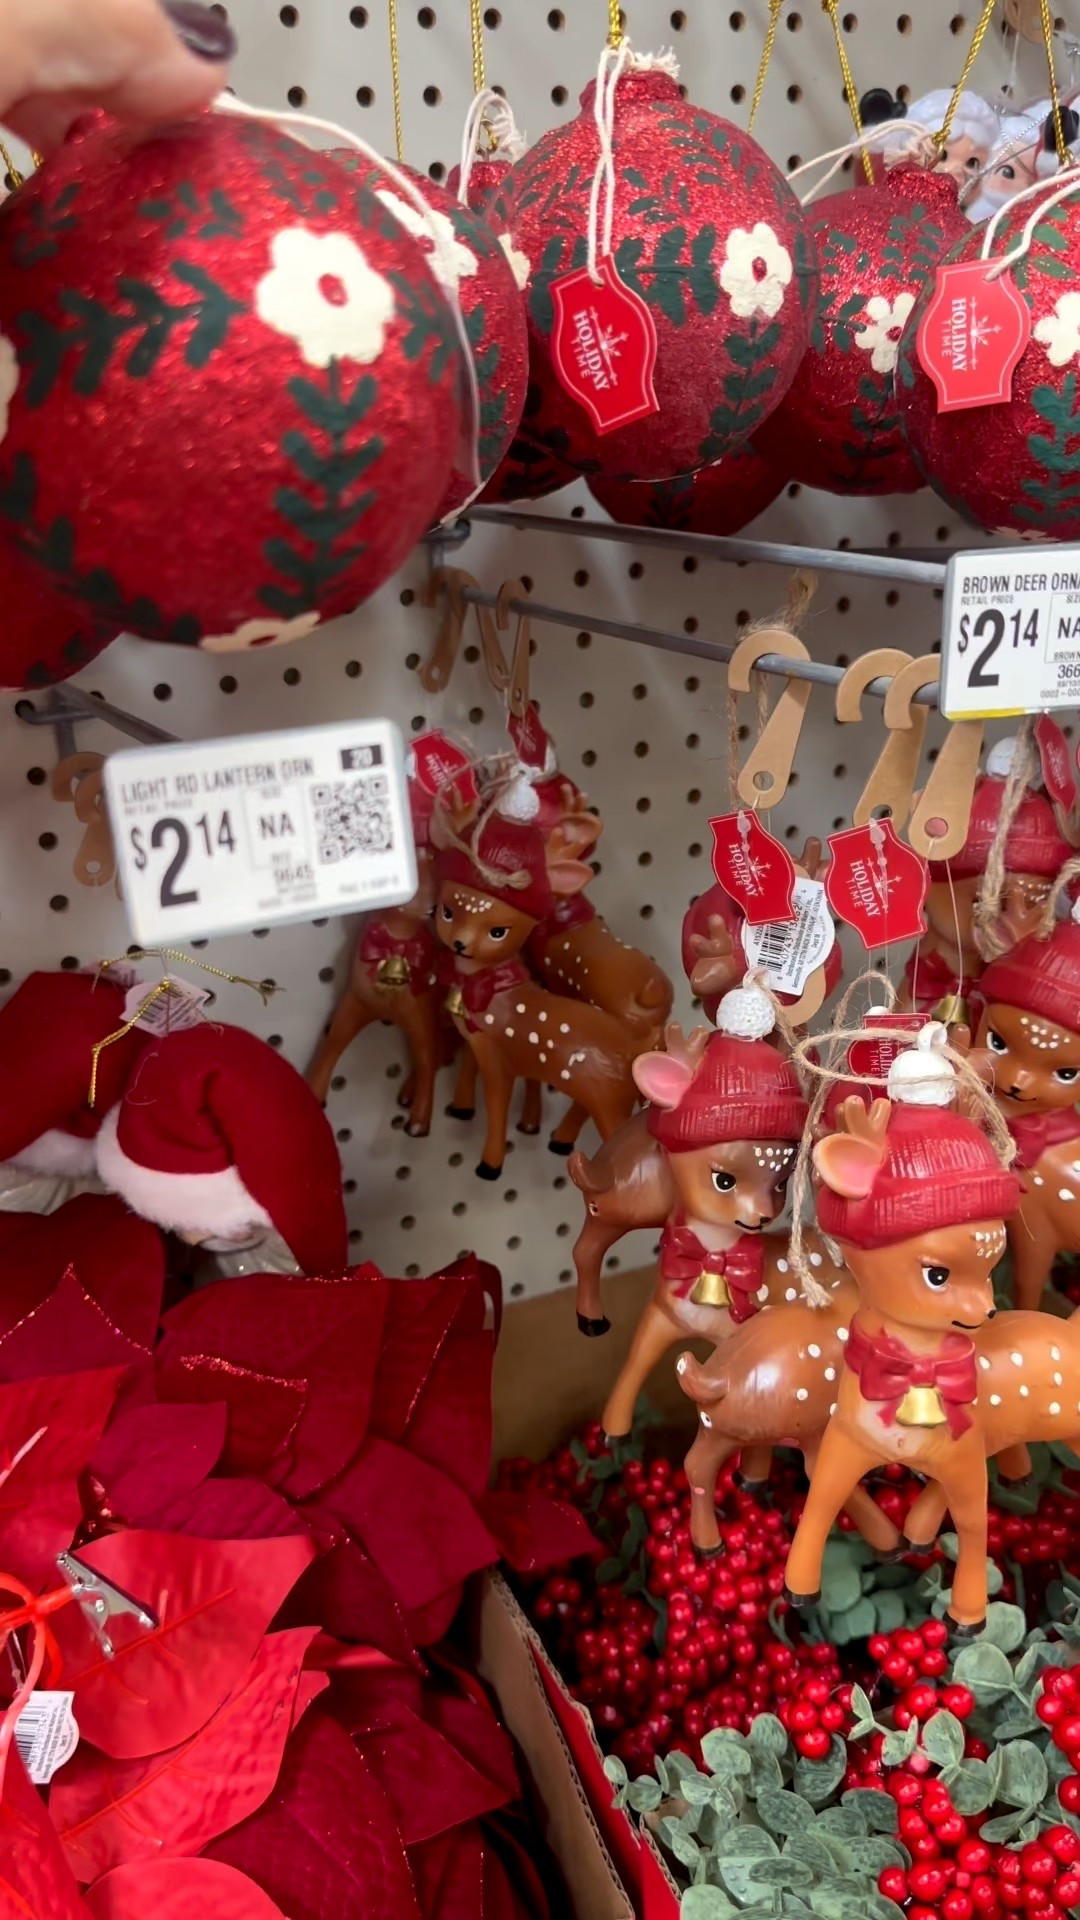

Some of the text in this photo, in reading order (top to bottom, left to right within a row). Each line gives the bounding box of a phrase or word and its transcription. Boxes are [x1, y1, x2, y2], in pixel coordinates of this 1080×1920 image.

[572, 309, 611, 391] HOLIDAY
[941, 319, 952, 358] TIME
[951, 297, 968, 372] HOLIDAY
[571, 337, 591, 379] TIME
[962, 575, 1011, 594] BROWN
[1014, 574, 1047, 592] DEER
[121, 777, 167, 803] LIGHT
[204, 762, 277, 793] LANTERN
[259, 812, 296, 840] NA
[727, 859, 744, 886] TIME
[728, 843, 759, 898] HOLIDAY
[850, 859, 882, 918] HOLIDAY
[846, 879, 864, 908] TIME
[870, 1049, 880, 1075] TIME
